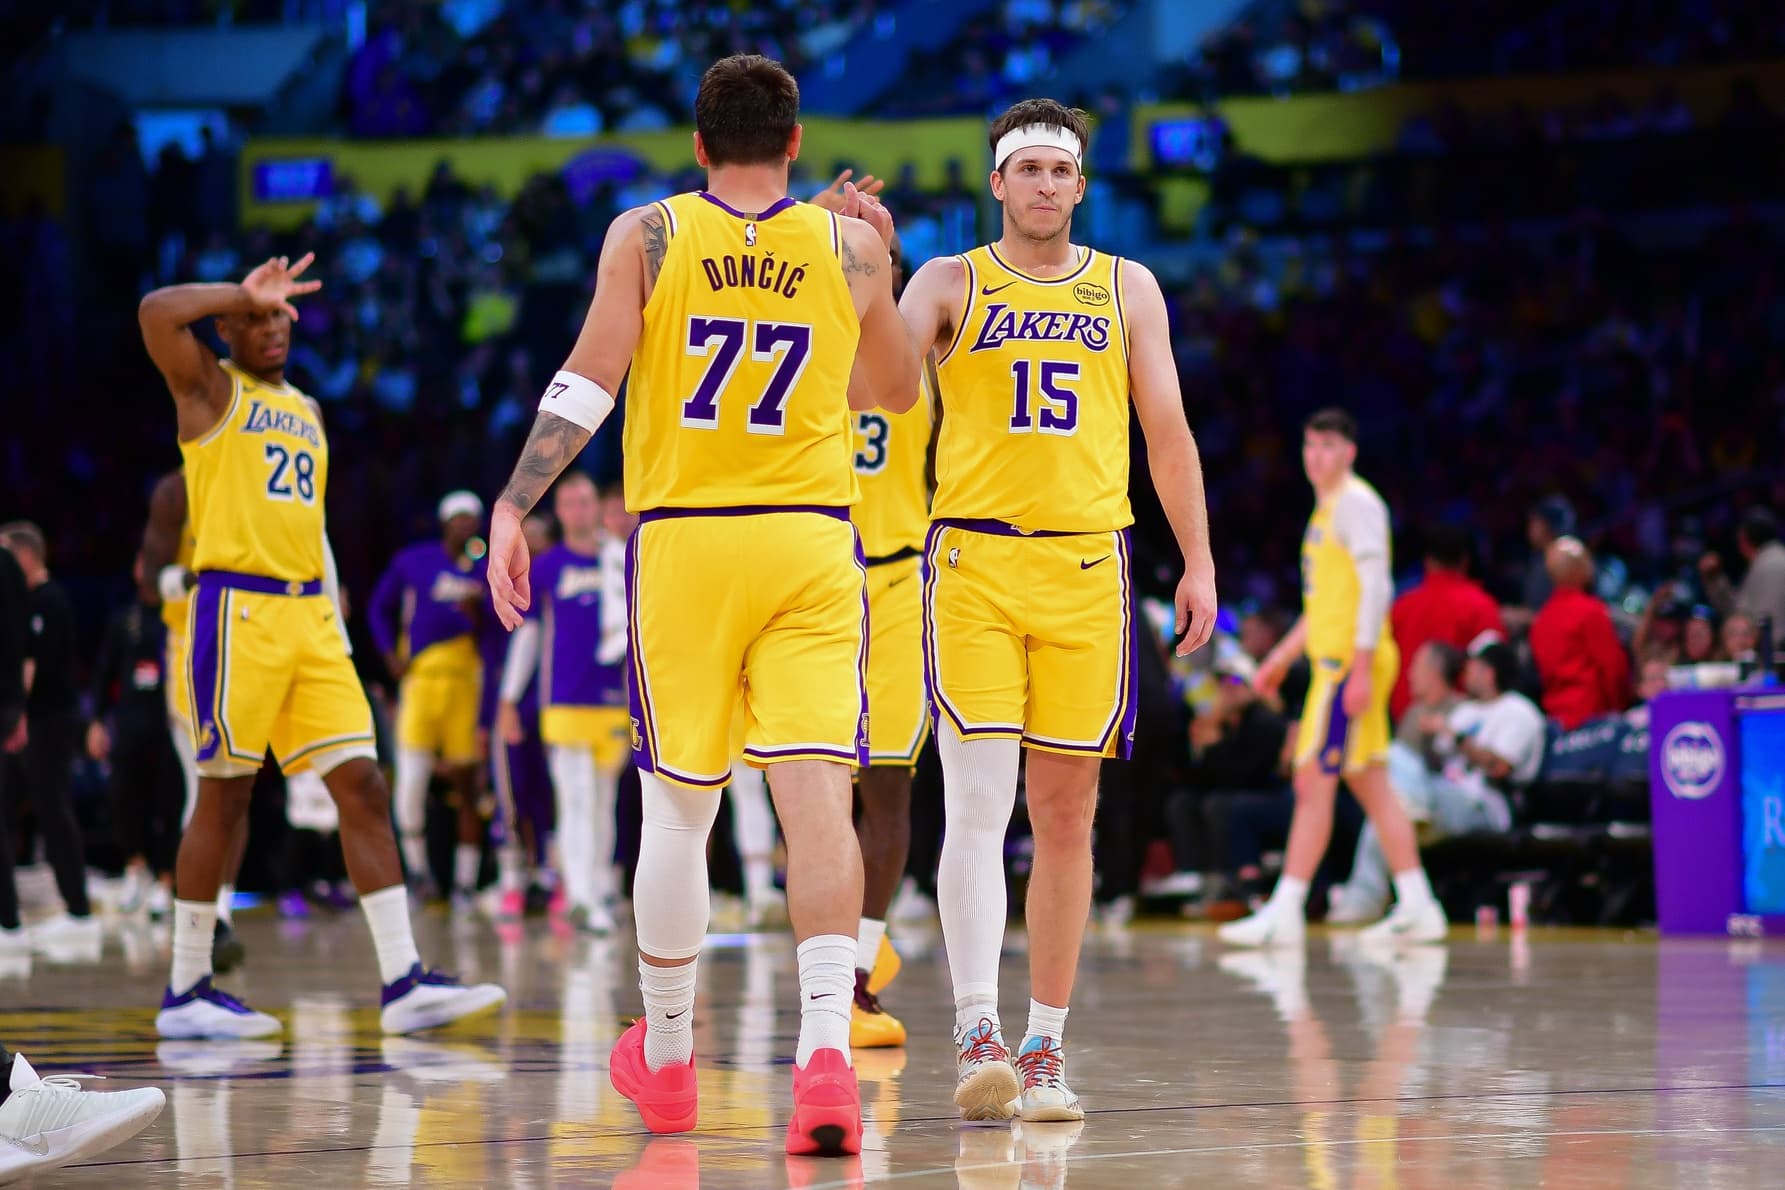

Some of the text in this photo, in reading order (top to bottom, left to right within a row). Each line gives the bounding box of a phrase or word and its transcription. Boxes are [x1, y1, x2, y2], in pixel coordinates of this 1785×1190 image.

[701, 251, 809, 299] DONČIĆ
[1076, 287, 1108, 300] bibigo
[968, 303, 1111, 354] LAKERS
[680, 315, 813, 435] 77
[1008, 359, 1081, 436] 15
[264, 443, 316, 505] 28
[853, 412, 890, 475] 3
